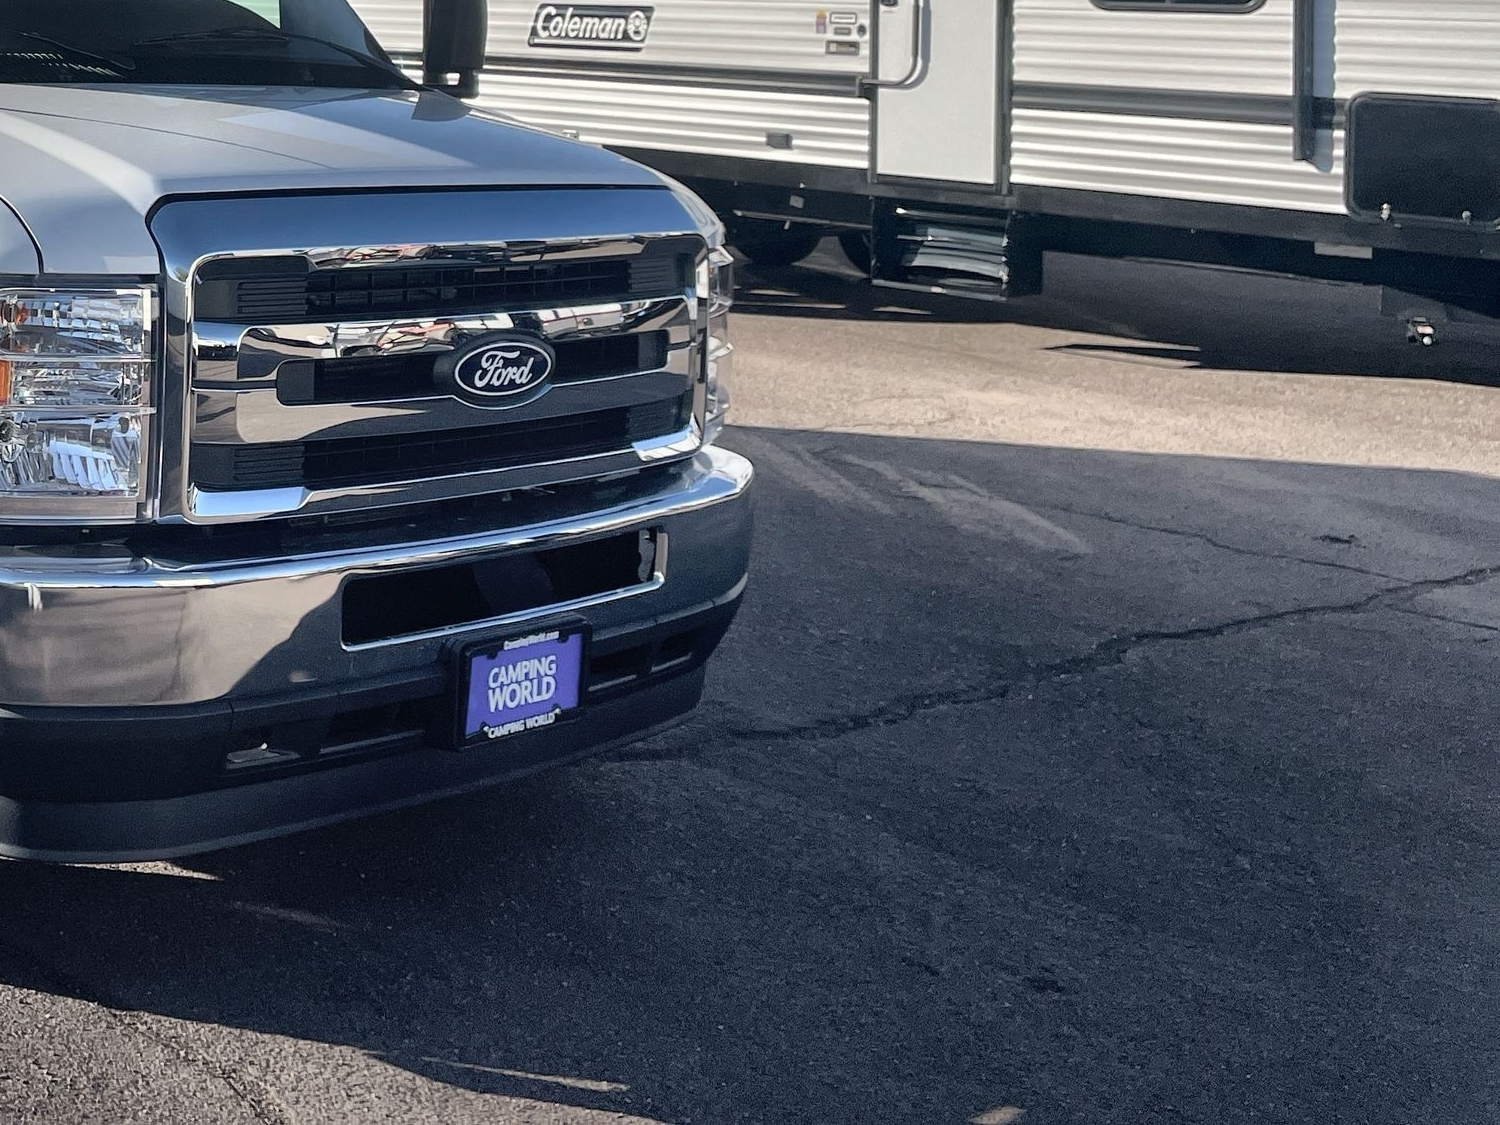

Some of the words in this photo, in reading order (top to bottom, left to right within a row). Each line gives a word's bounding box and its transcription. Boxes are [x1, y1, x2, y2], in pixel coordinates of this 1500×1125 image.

[536, 6, 627, 40] Coleman
[474, 350, 535, 388] Ford
[488, 655, 557, 689] CAMPING
[487, 676, 556, 713] WORLD
